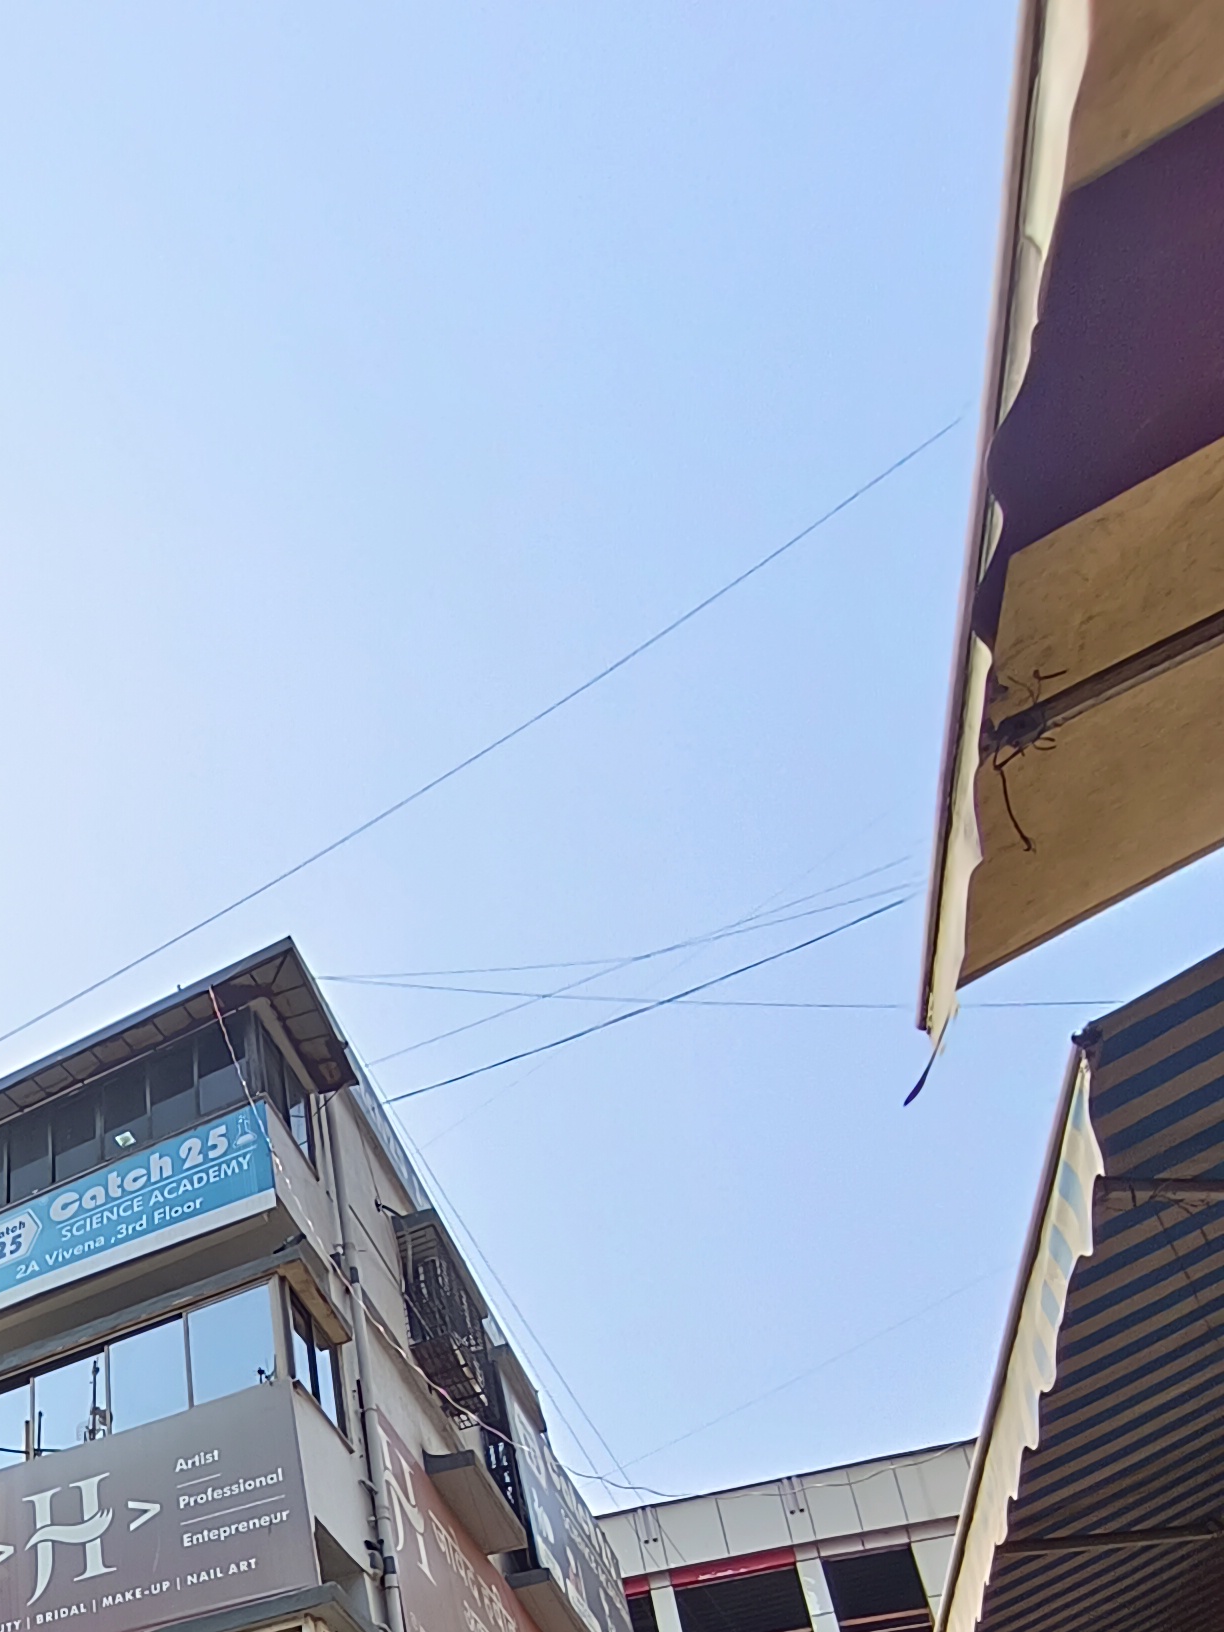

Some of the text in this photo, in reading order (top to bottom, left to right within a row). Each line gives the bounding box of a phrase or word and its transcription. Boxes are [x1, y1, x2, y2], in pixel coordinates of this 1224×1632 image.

[49, 1124, 228, 1222] Catch 25
[60, 1152, 254, 1241] SCIENCE ACADEMY
[16, 1259, 40, 1279] 2A
[45, 1234, 106, 1267] Vivena
[154, 1197, 204, 1225] Floor
[175, 1449, 220, 1473] Artist
[178, 1468, 284, 1510] Professional
[182, 1508, 291, 1548] Entepreneur
[36, 1604, 87, 1626] BRIDAL
[102, 1580, 171, 1608] MAKE-UP
[186, 1566, 224, 1586] NAIL
[228, 1557, 258, 1576] ART
